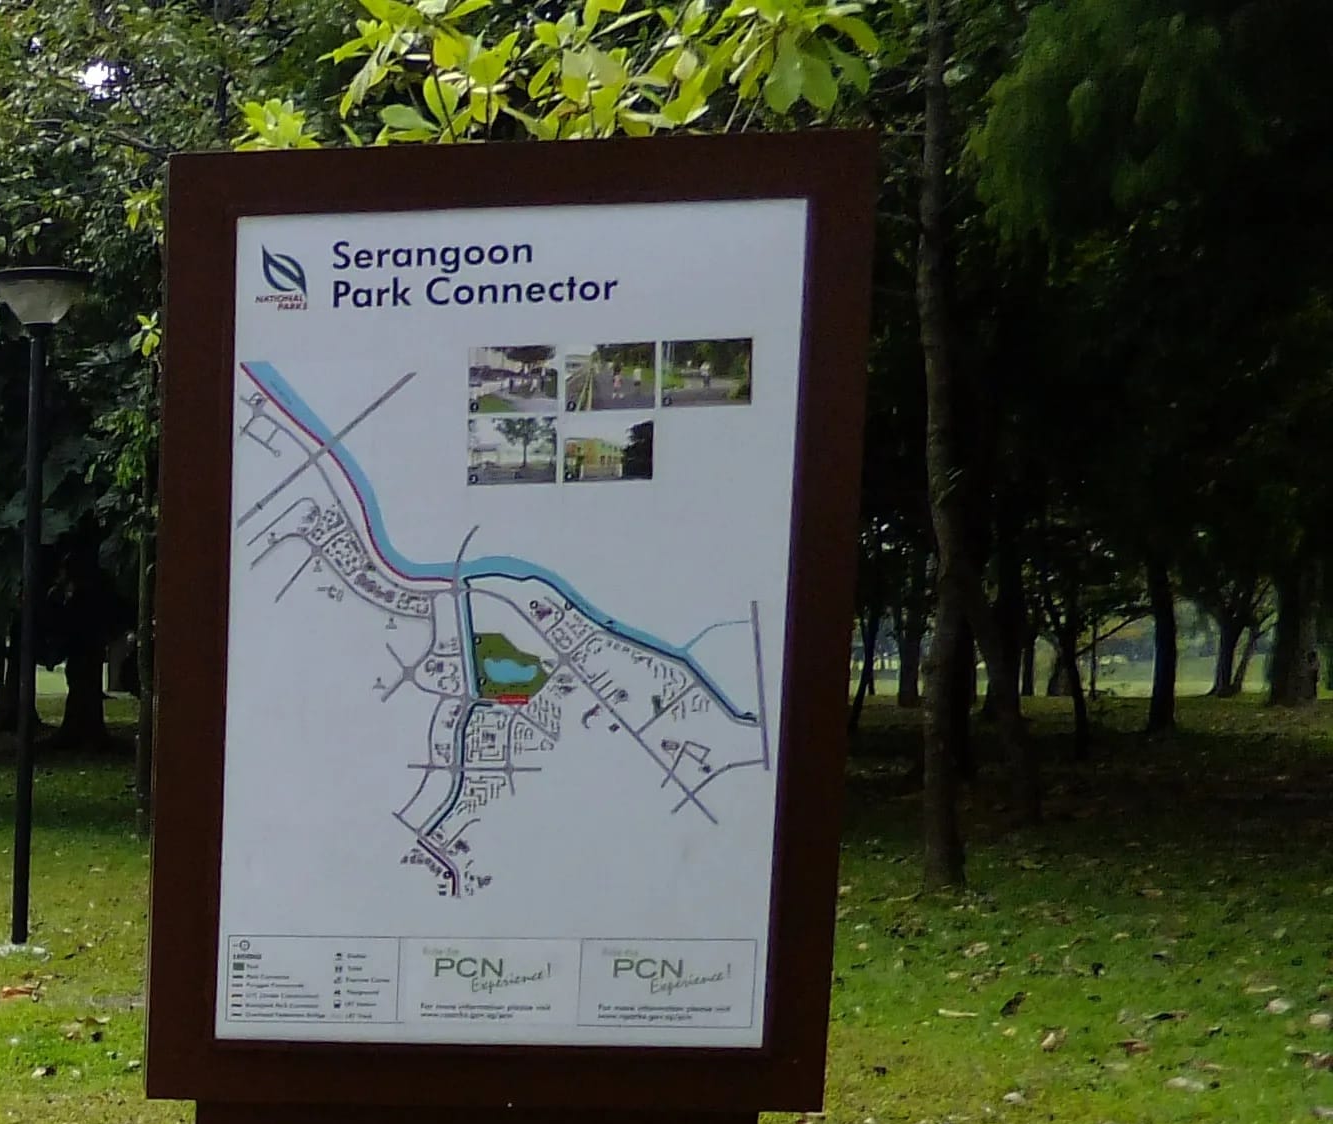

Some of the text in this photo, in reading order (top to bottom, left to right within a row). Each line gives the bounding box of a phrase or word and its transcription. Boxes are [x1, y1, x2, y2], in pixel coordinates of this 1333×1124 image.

[332, 241, 533, 274] Serangoon
[255, 294, 304, 303] NATIONAL
[332, 276, 619, 309] Park Connector
[434, 957, 504, 978] PCN
[612, 958, 684, 979] PCN
